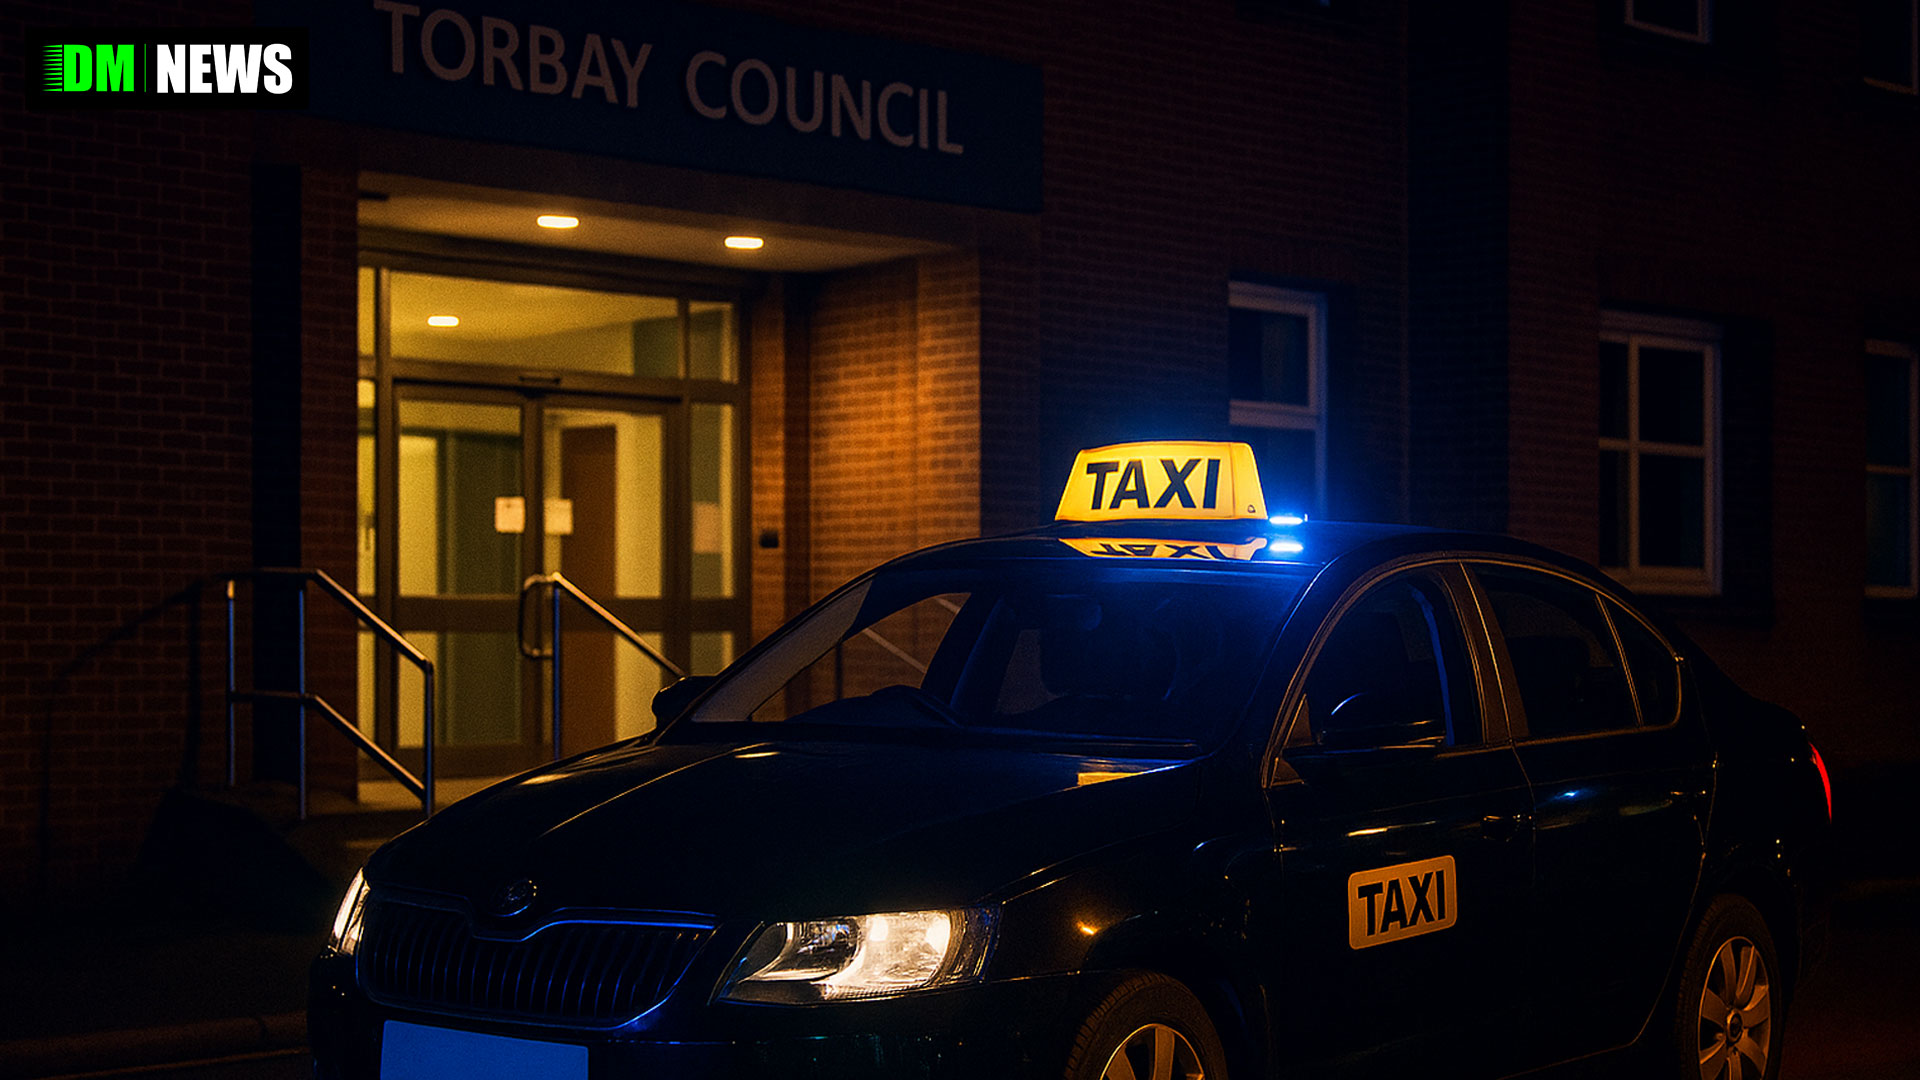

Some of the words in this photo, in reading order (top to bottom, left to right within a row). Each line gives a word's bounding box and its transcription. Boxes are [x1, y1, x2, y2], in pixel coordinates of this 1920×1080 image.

[373, 0, 653, 108] TORBAY
[685, 50, 965, 155] COUNCIL
[1086, 458, 1221, 510] TAXI
[1358, 869, 1446, 936] TAXI
